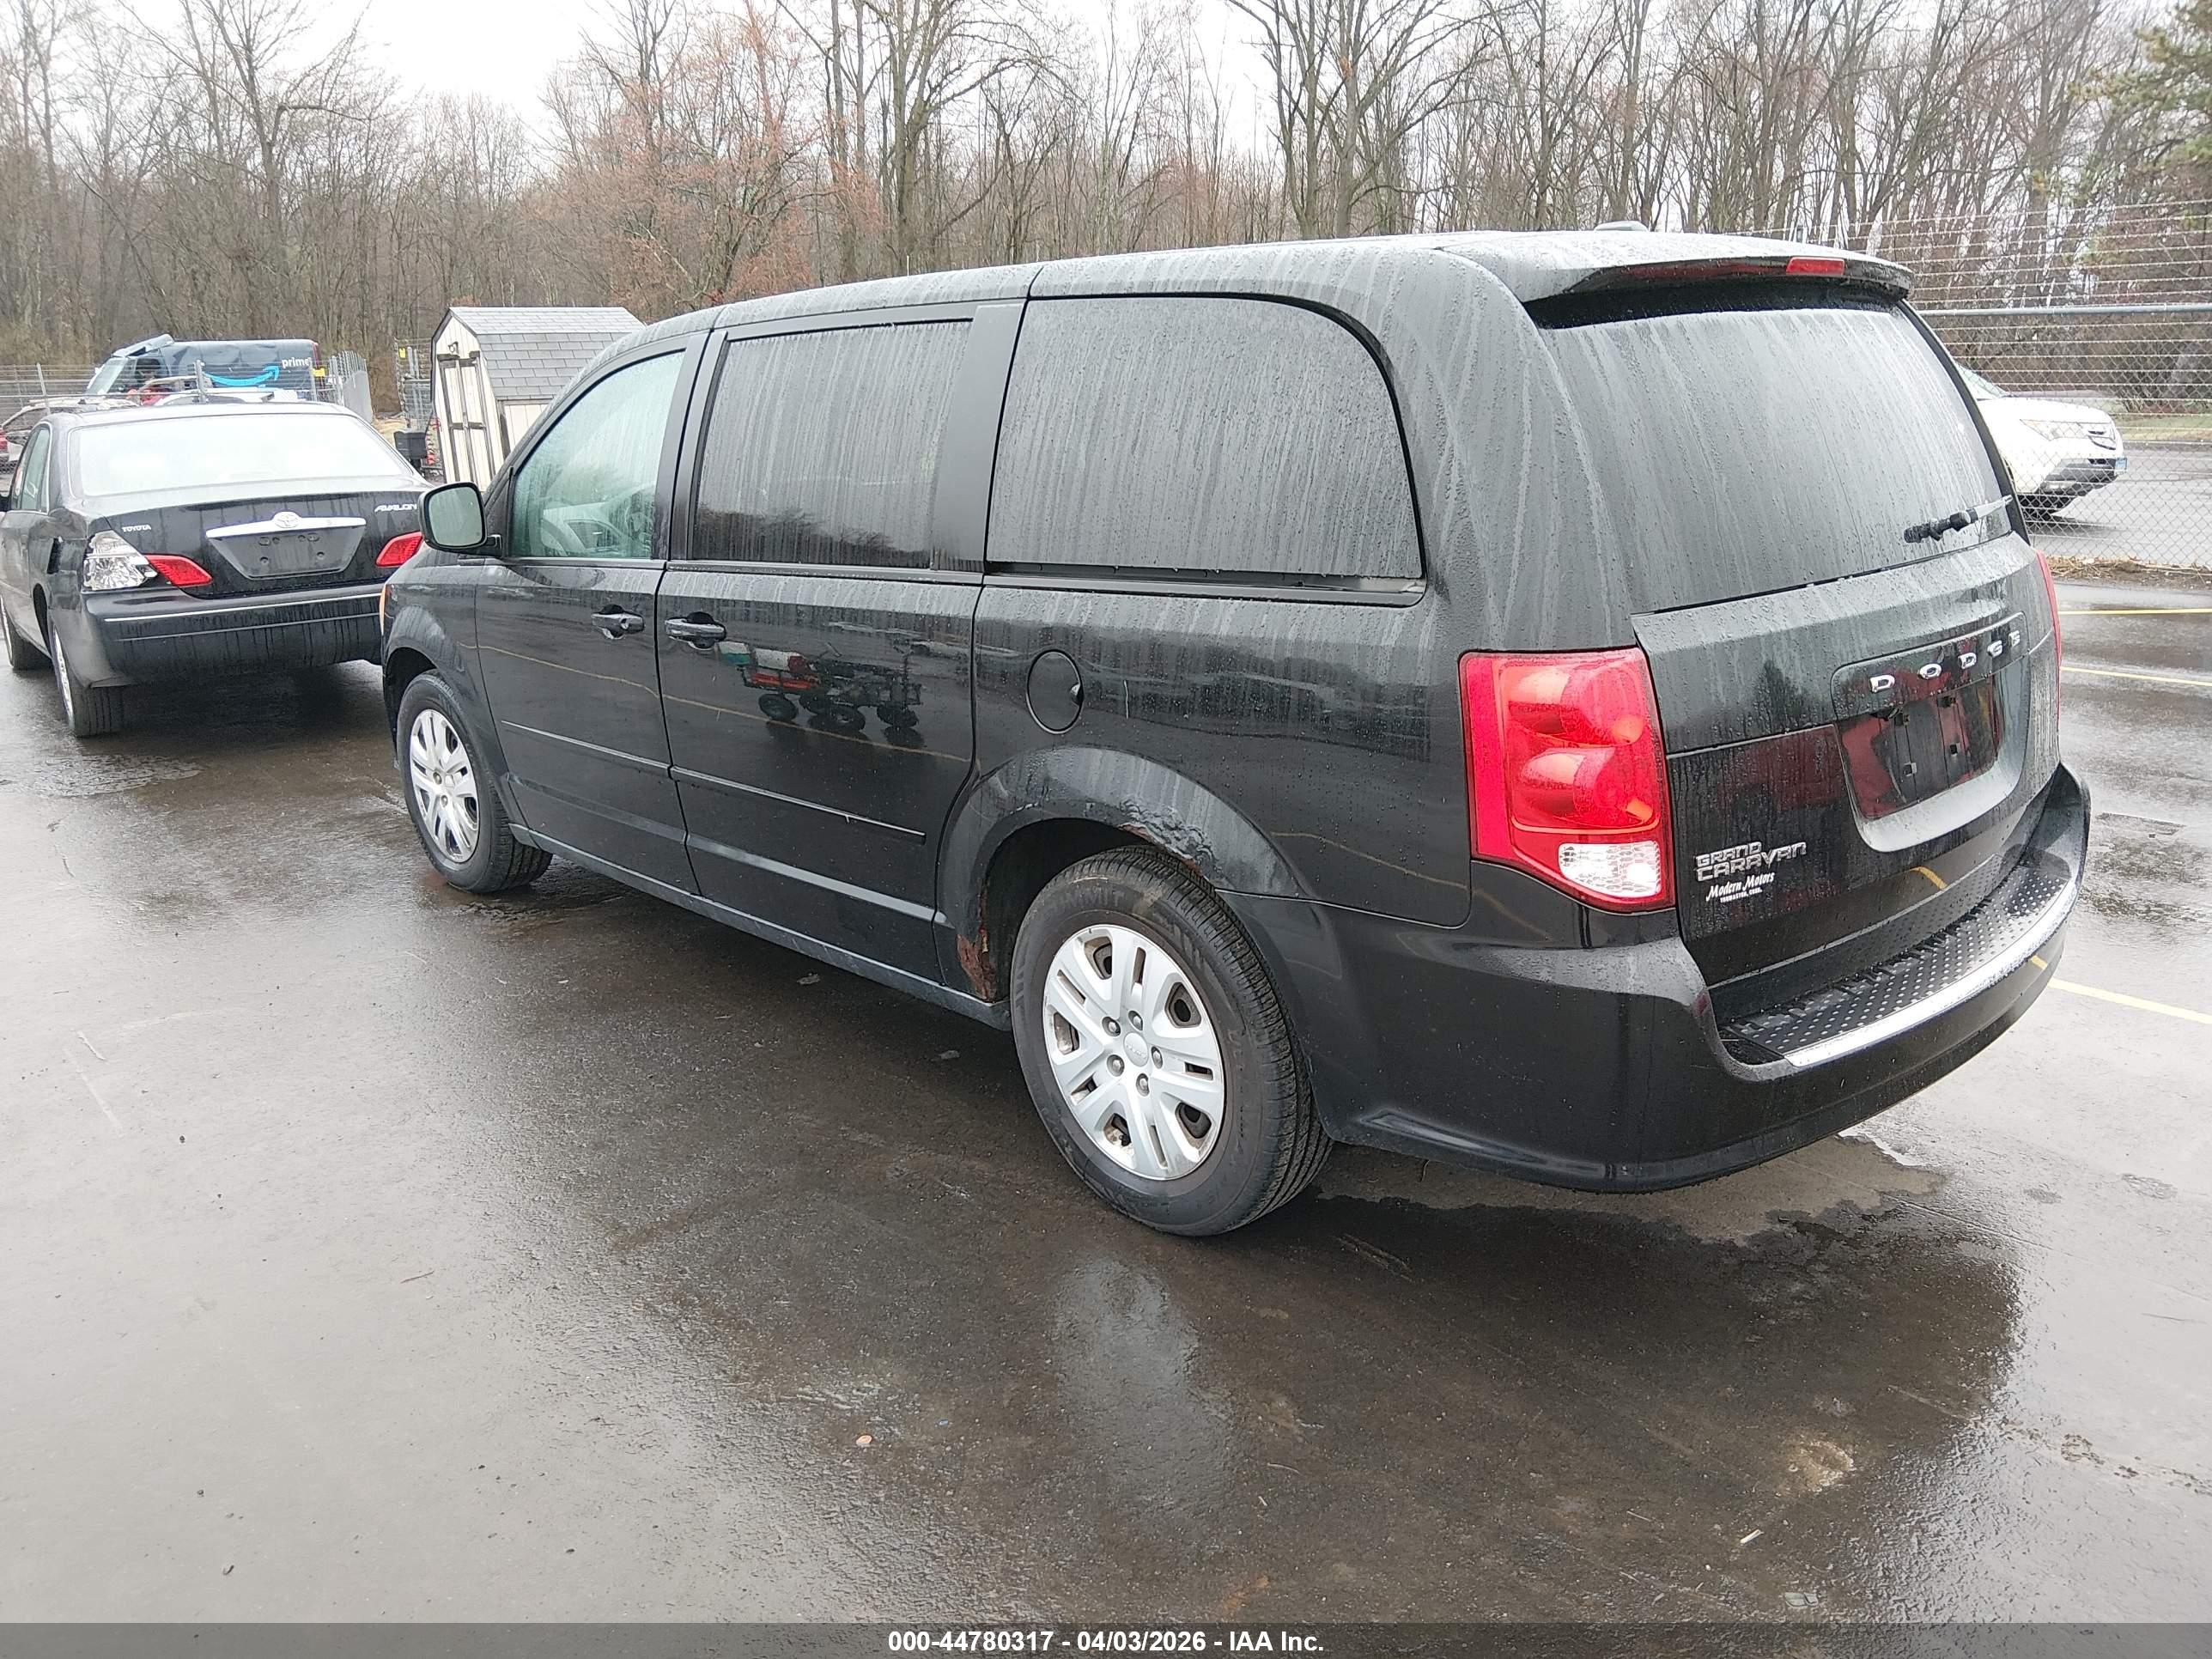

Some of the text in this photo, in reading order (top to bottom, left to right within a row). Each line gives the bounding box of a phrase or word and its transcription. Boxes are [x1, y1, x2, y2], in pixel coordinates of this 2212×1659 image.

[282, 356, 309, 368] prime
[374, 503, 417, 513] AVALON
[121, 524, 152, 532] TOYOTA
[1869, 629, 2021, 693] DODGE
[1696, 842, 1762, 867] GRAND
[1696, 842, 1807, 881] CARAVAN
[1705, 872, 1775, 902] Modern Motors
